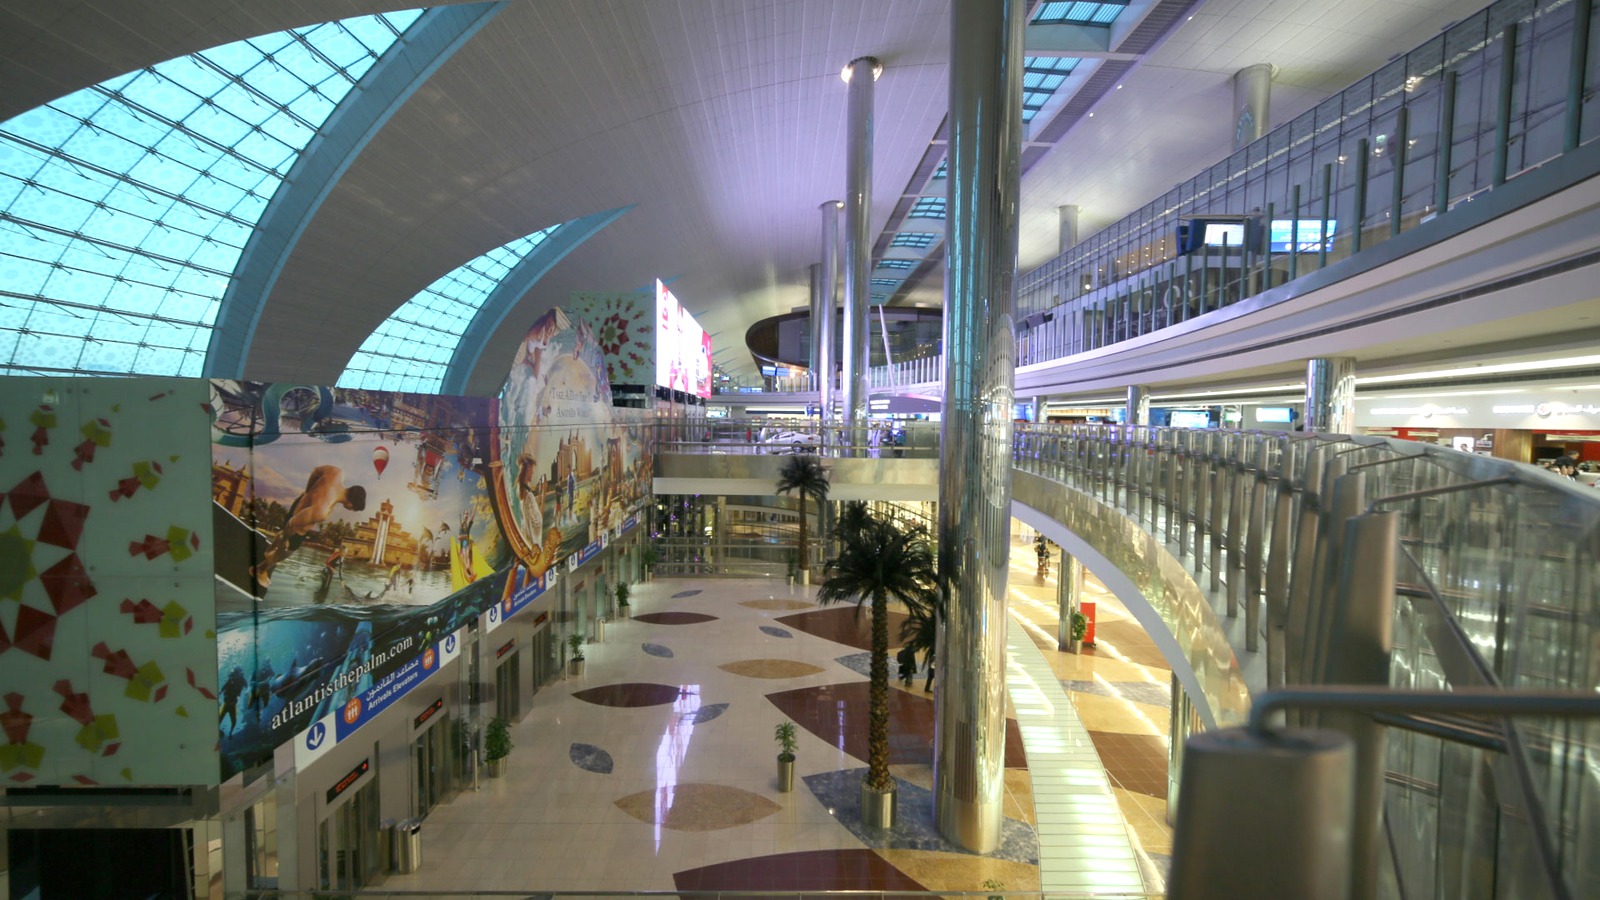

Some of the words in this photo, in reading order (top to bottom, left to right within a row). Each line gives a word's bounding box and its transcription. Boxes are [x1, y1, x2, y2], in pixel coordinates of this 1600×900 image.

[271, 636, 413, 730] atlantisthepalm.com
[367, 689, 392, 711] Arrivals
[392, 671, 419, 693] Elevators
